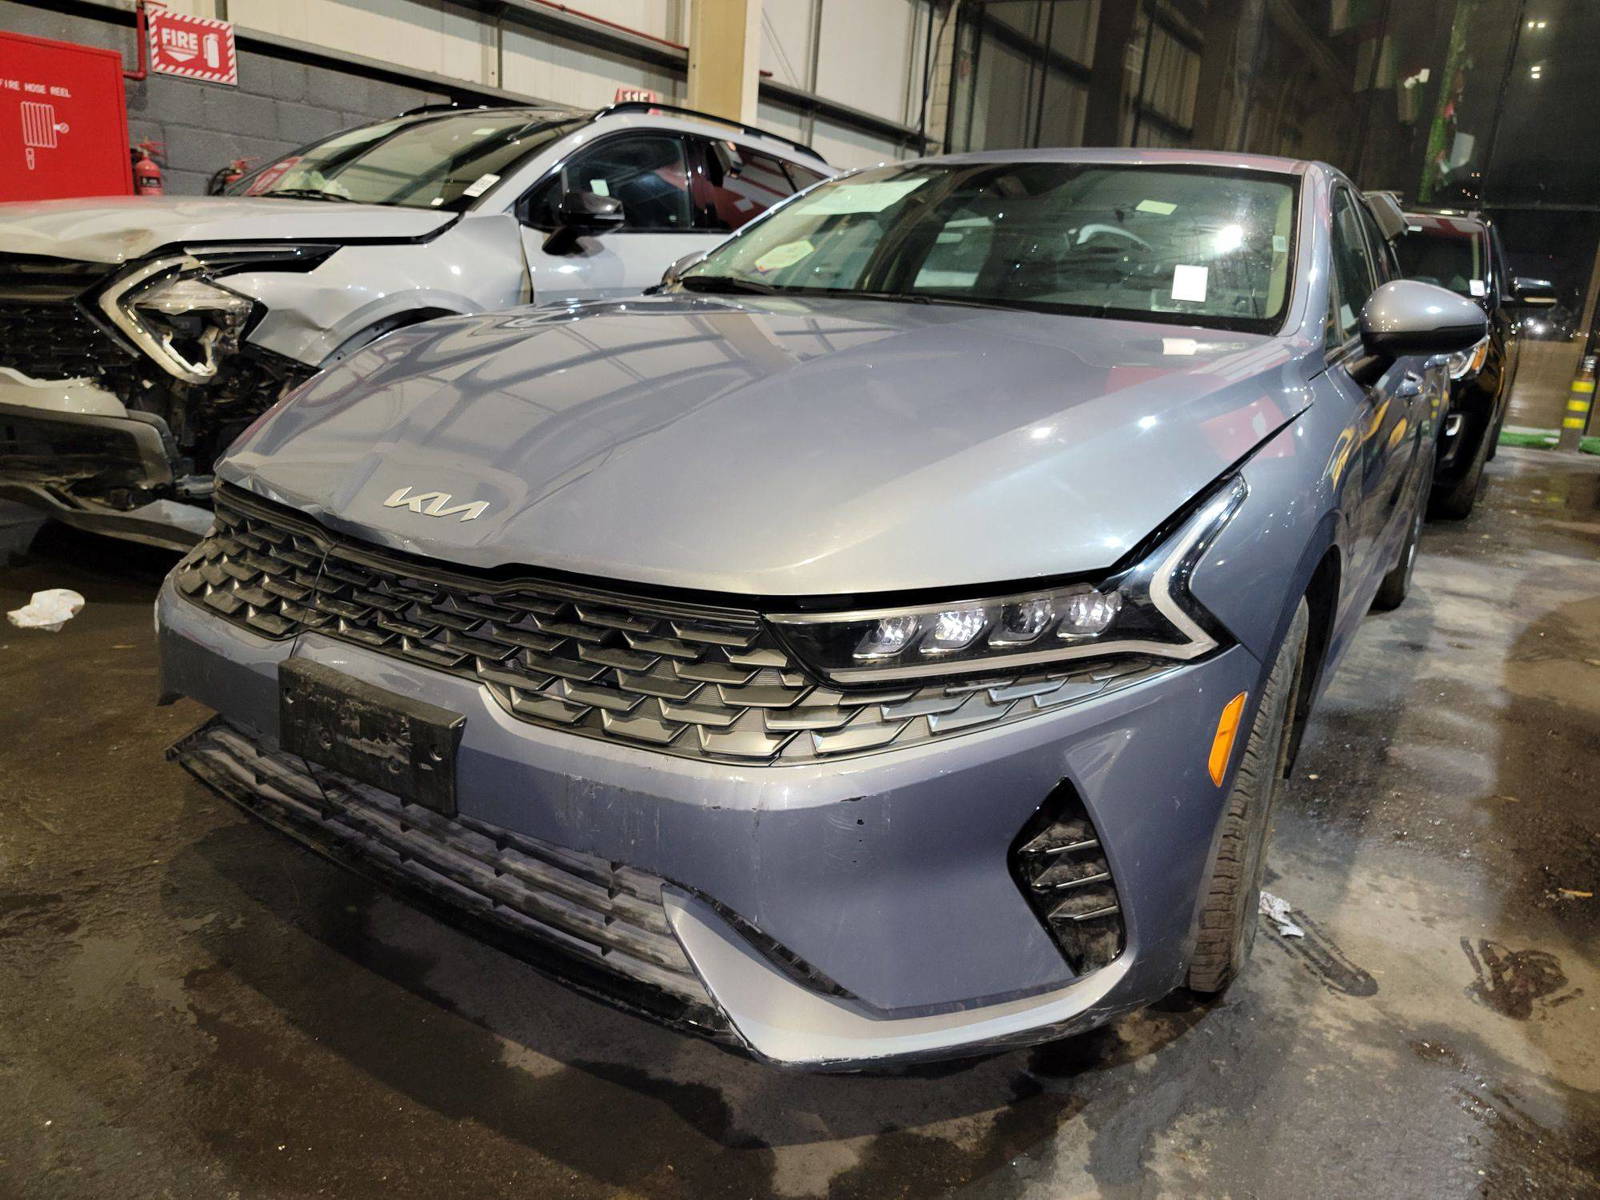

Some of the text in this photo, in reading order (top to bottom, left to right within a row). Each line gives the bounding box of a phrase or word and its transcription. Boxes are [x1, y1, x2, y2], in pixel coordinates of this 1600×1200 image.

[161, 28, 198, 49] FIRE
[24, 82, 46, 95] HOSE
[50, 86, 72, 98] REEL
[383, 486, 490, 522] KIA
